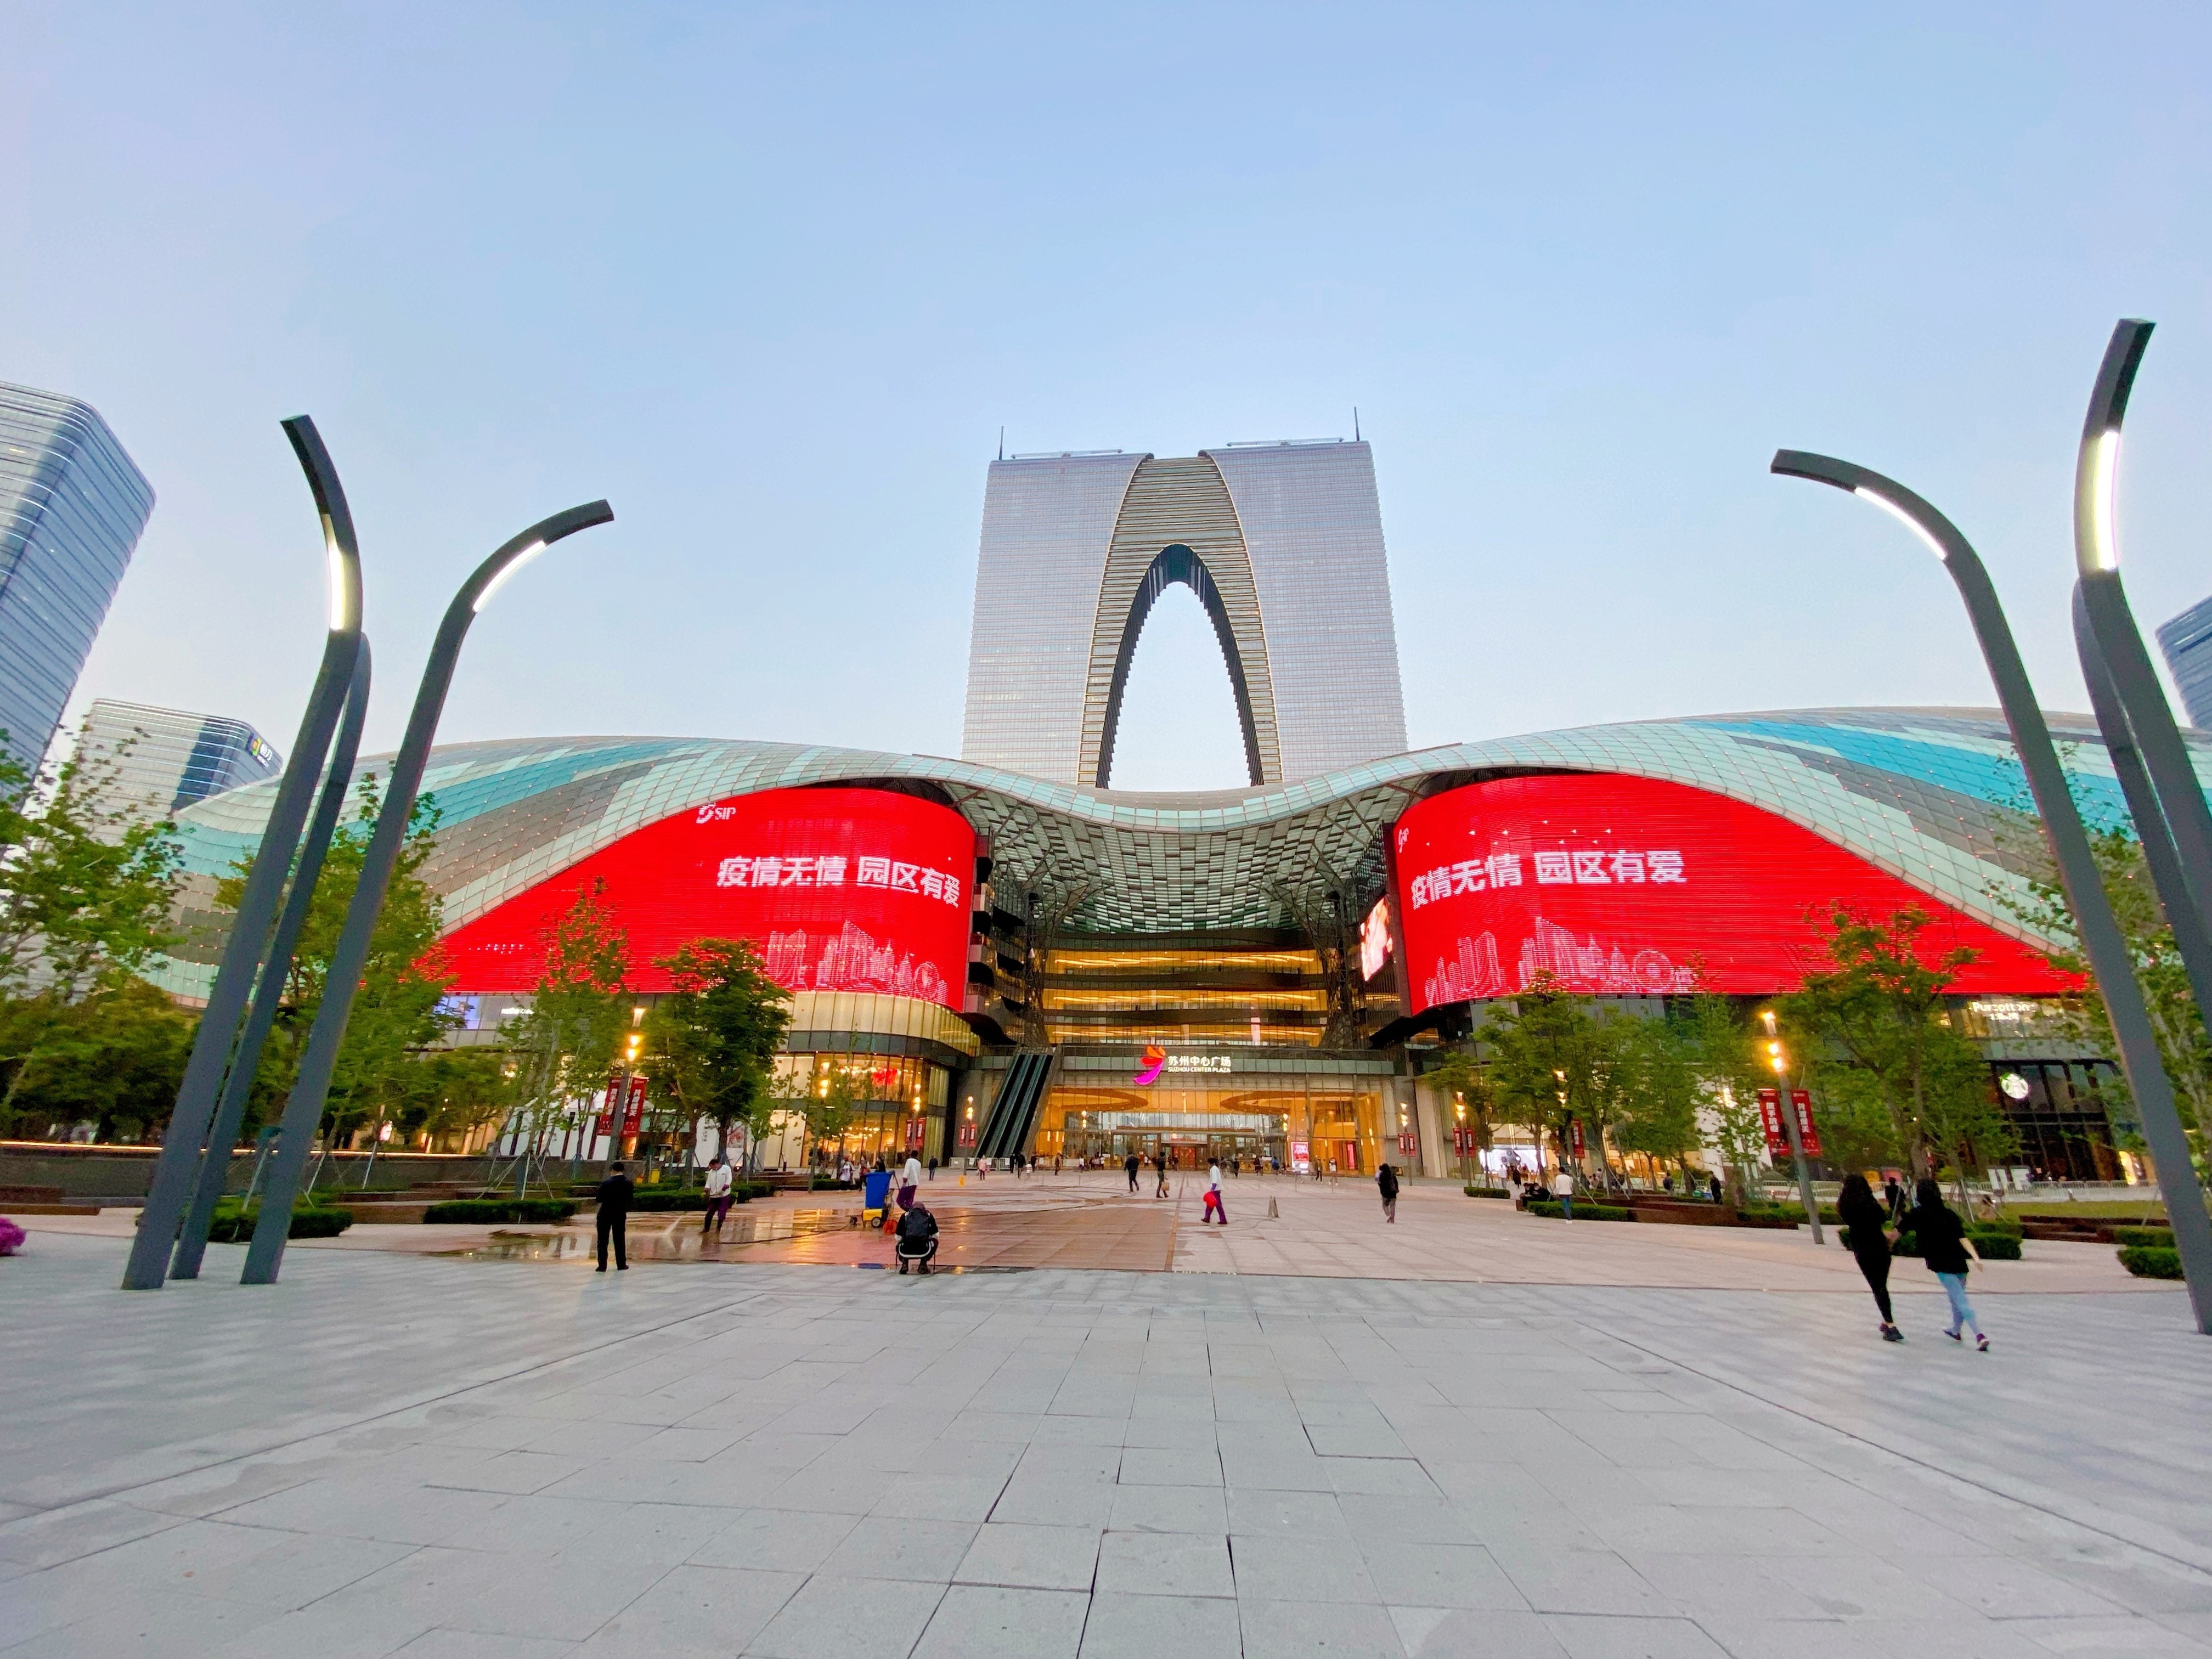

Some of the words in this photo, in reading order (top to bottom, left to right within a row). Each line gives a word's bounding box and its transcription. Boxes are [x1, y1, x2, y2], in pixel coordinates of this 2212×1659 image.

[715, 807, 736, 820] SIP
[717, 856, 847, 887] 疫情无情
[857, 856, 960, 909] 园区有爱
[1410, 853, 1522, 910] 疫情无情
[1534, 850, 1687, 884] 园区有爱
[1168, 1056, 1231, 1066] 苏州中心广场
